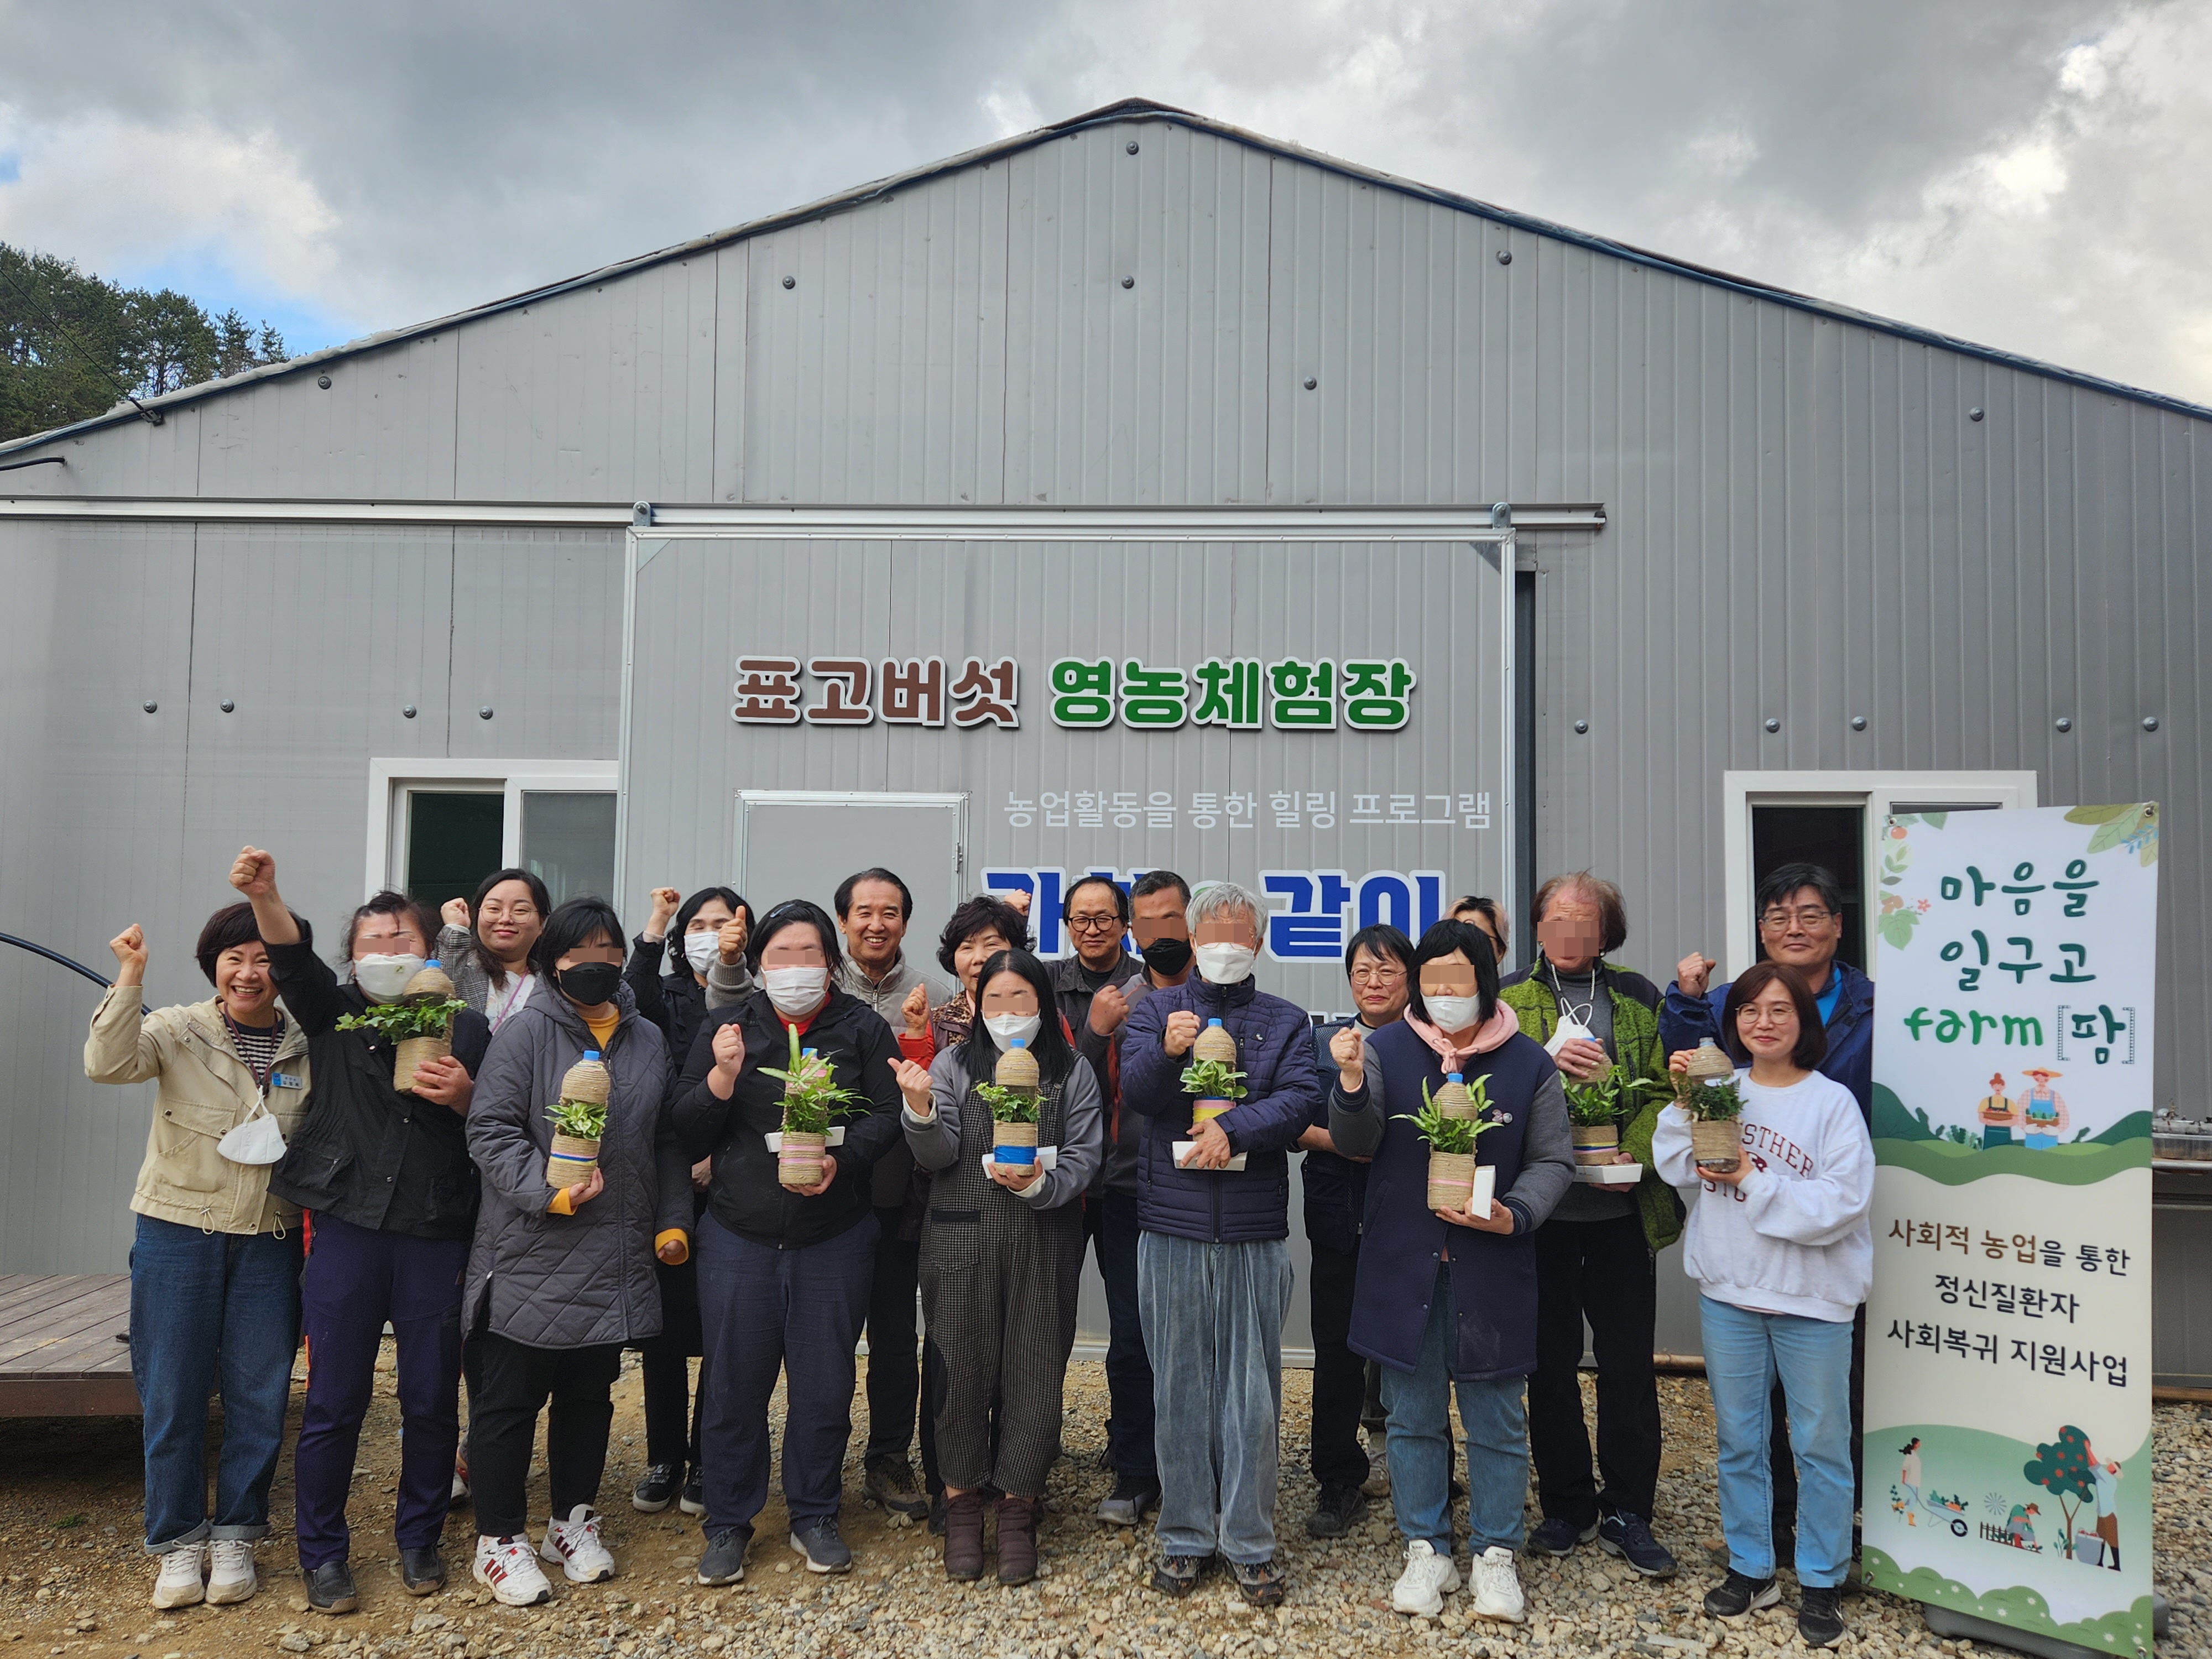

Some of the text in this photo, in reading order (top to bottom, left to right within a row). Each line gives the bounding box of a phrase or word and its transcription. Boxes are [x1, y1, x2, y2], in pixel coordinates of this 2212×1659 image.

[731, 655, 1416, 730] 표고버섯 영농체험장
[1004, 791, 1491, 830] 농업활동을 통한 힐링 프로그램
[1940, 859, 2100, 917] 마음을
[1940, 930, 2096, 992] 일구고
[1888, 1219, 2131, 1276] 사회적 농업을 통한
[1935, 1275, 2080, 1324] 정신질환자
[1887, 1319, 2127, 1387] 사회복귀 지원사업
